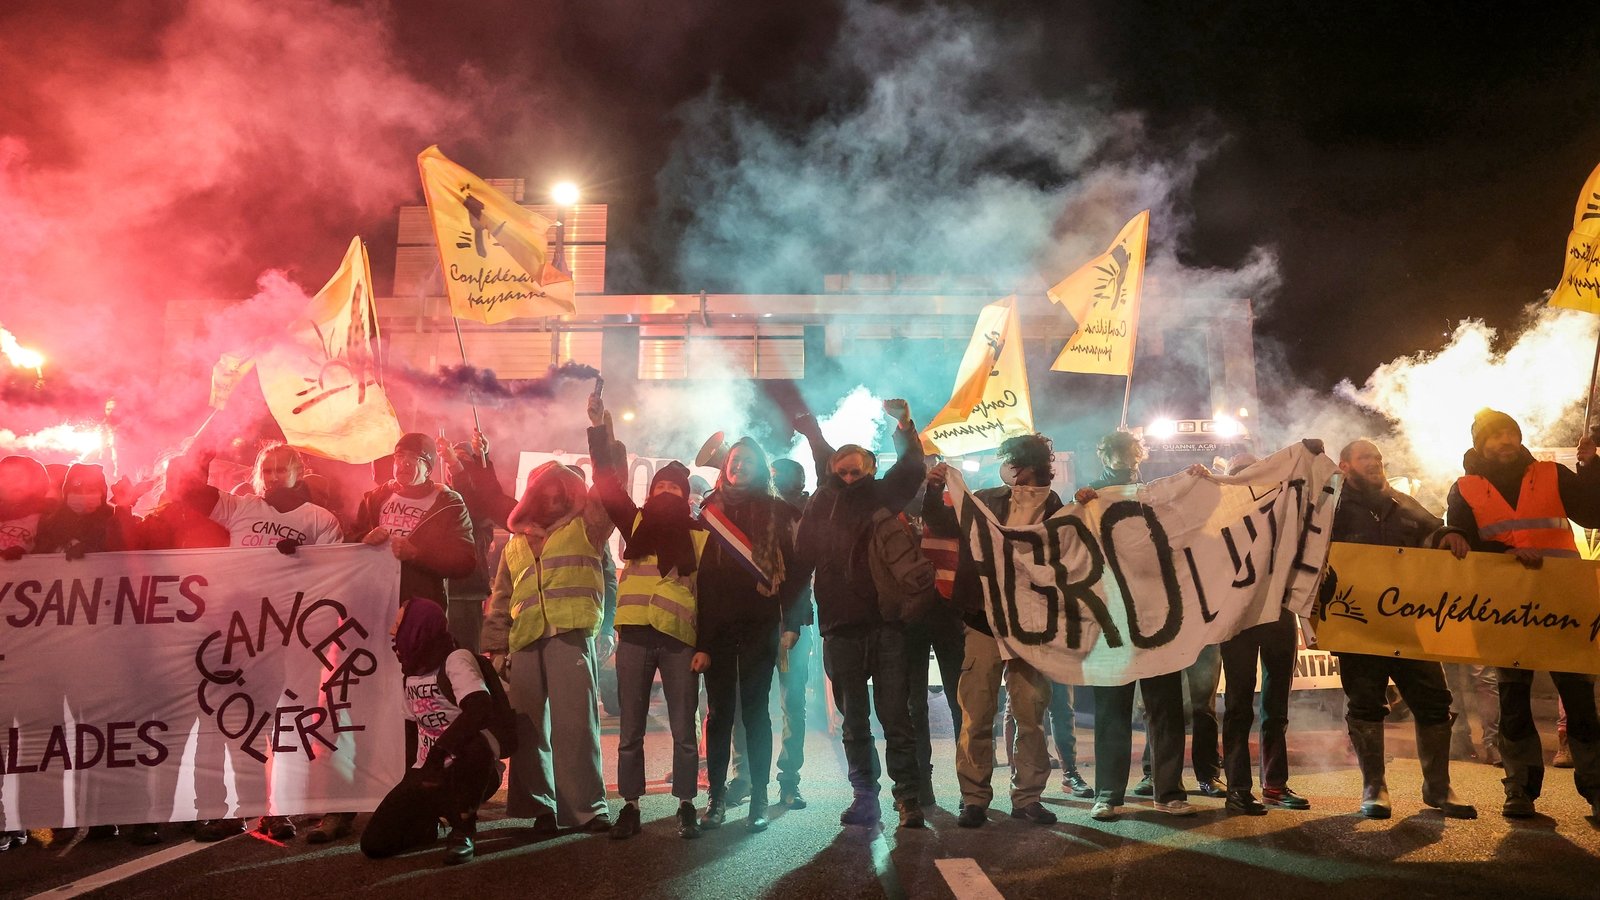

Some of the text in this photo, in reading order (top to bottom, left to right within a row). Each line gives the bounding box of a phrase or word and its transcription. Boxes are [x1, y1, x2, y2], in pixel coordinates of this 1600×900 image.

[468, 290, 546, 312] paysanne
[251, 521, 307, 546] CANCER
[957, 491, 1184, 649] AGRO
[1377, 586, 1581, 633] Confédération
[195, 591, 378, 702] CANCER
[0, 720, 169, 774] LADES
